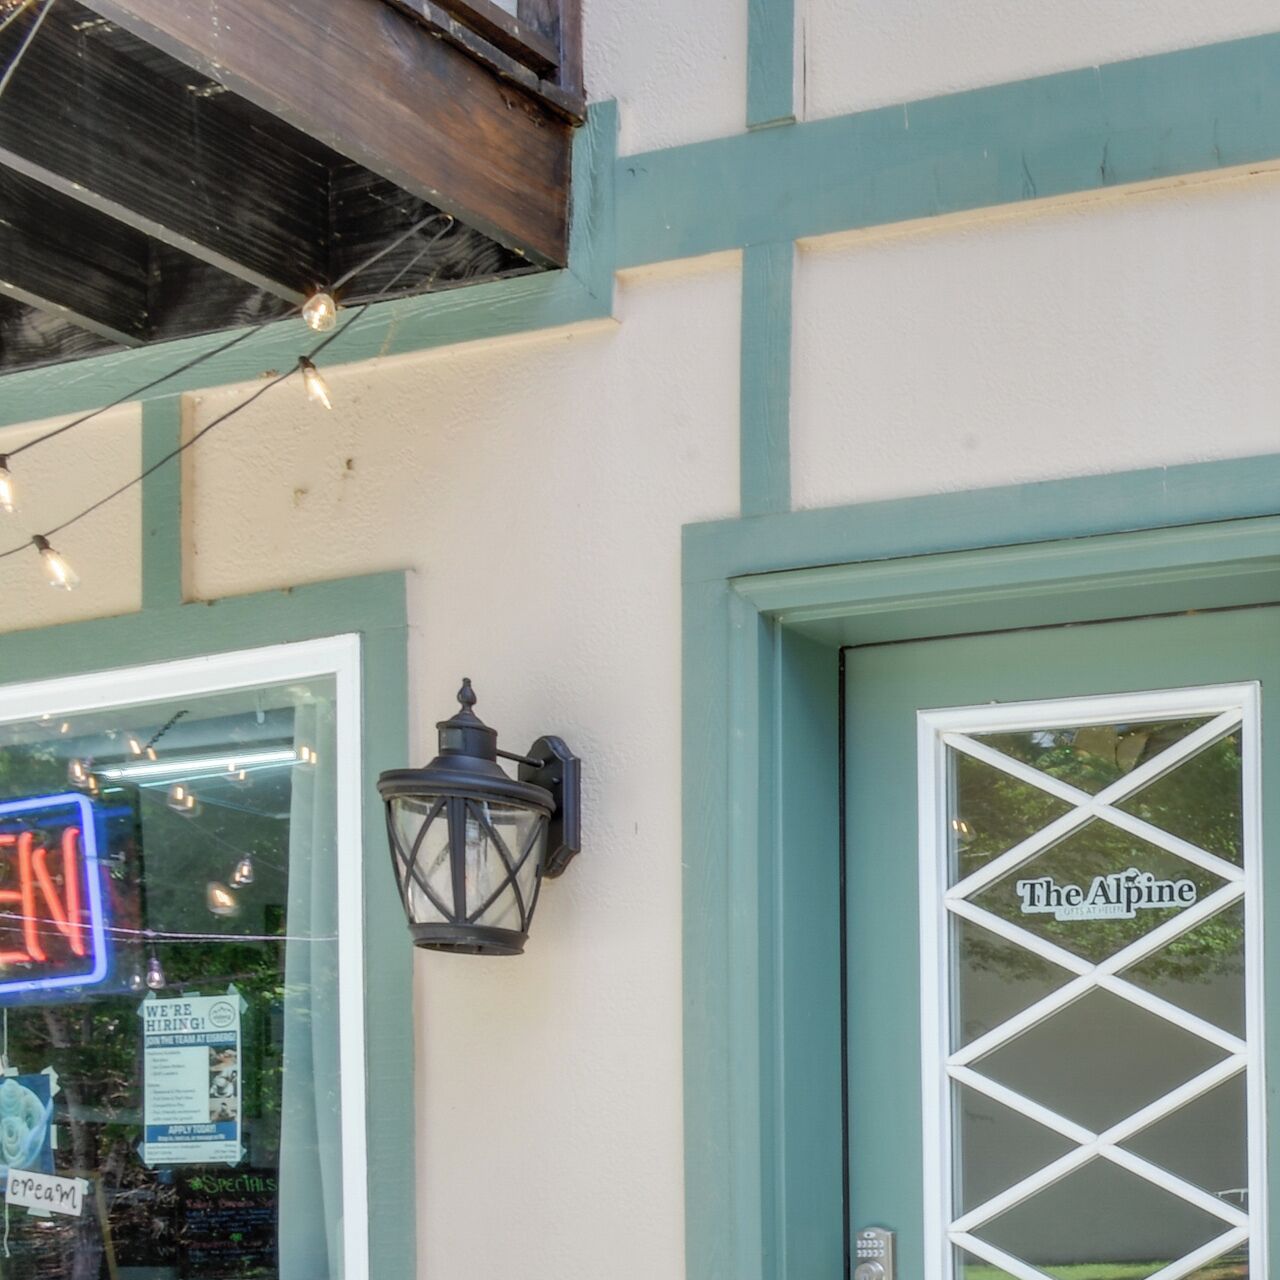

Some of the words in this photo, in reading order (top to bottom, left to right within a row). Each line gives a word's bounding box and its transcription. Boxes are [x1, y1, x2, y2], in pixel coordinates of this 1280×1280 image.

[1022, 880, 1082, 907] The
[1090, 874, 1195, 913] Alpine
[146, 1003, 192, 1018] WE'RE
[146, 1017, 206, 1032] HIRING!
[175, 1034, 196, 1044] TEAM
[197, 1033, 207, 1043] AT
[168, 1125, 191, 1135] APPLY
